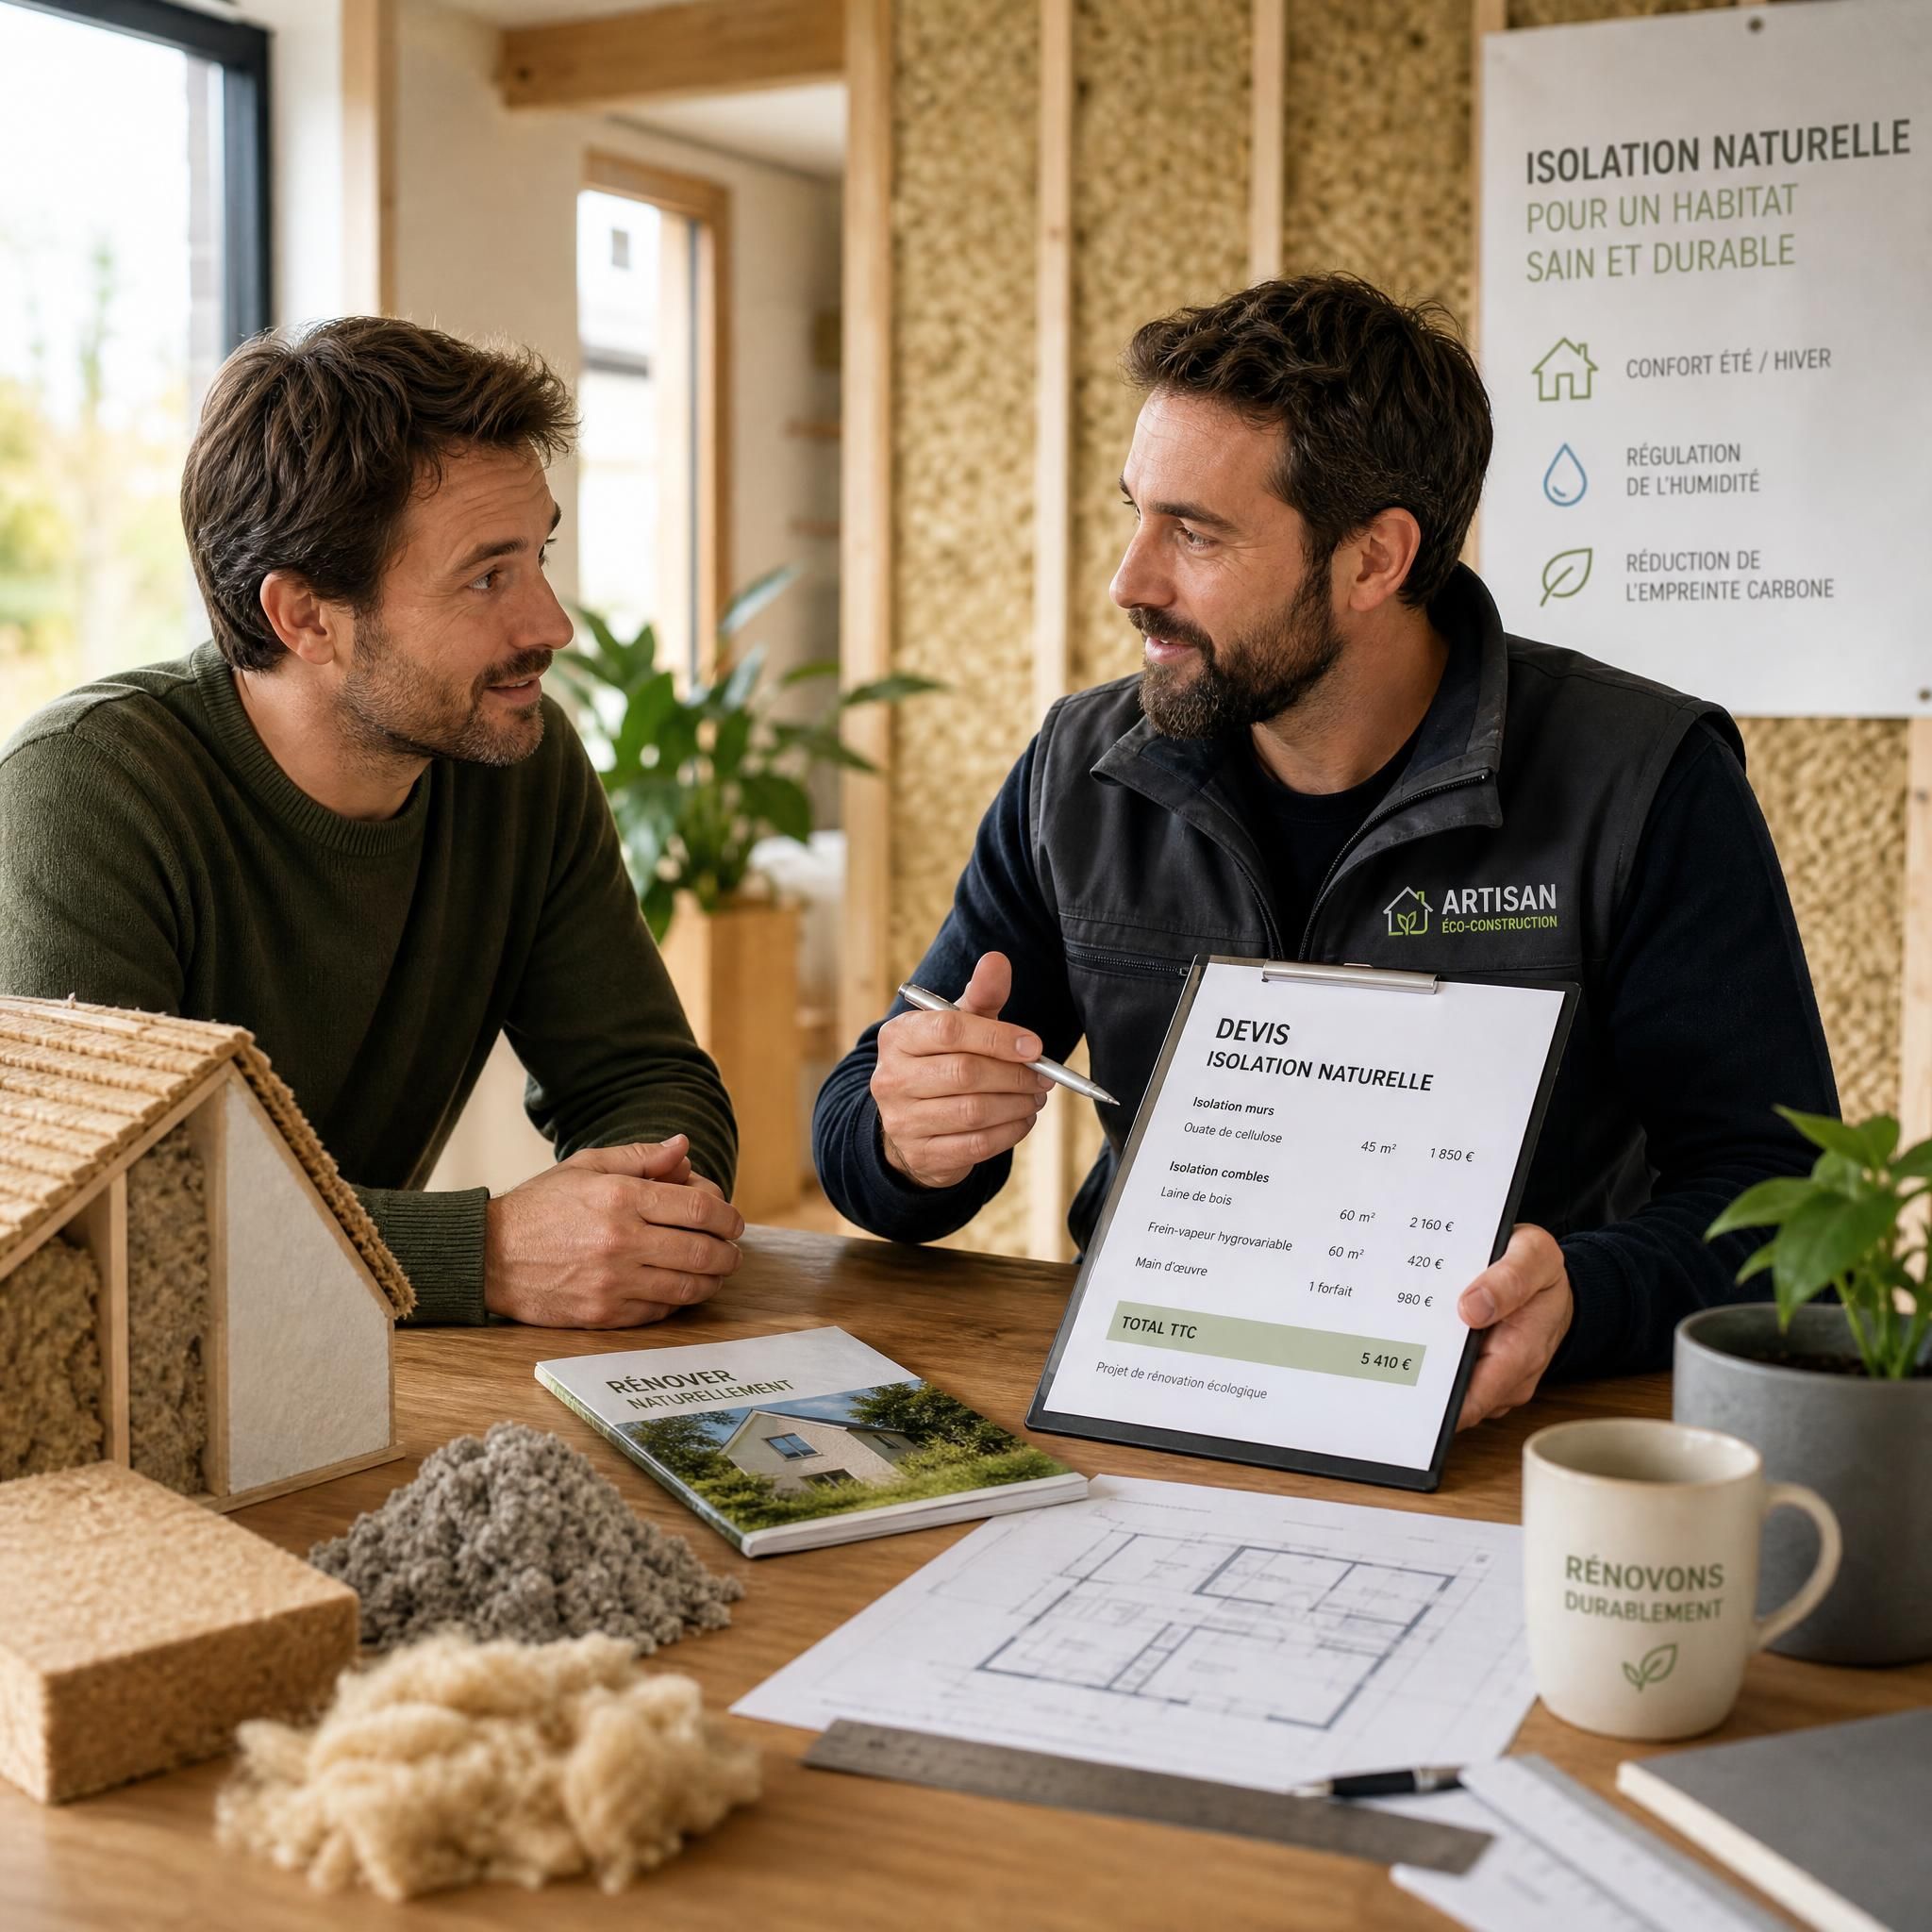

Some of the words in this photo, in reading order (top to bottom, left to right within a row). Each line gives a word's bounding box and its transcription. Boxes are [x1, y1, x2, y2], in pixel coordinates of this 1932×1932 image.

[1527, 138, 1699, 184] ISOLATION
[1714, 119, 1910, 170] NATURELLE
[1527, 198, 1607, 234] POUR
[1620, 193, 1660, 227] UN
[1674, 183, 1798, 223] HABITAT
[1526, 247, 1594, 282] SAIN
[1607, 244, 1642, 277] ET
[1654, 233, 1795, 275] DURABLE
[1626, 355, 1713, 379] CONFORT
[1721, 348, 1752, 374] ÉTÉ
[1758, 350, 1768, 374] /
[1774, 348, 1831, 370] HIVER
[1627, 443, 1740, 466] RÉGULATION
[1627, 476, 1650, 496] DE
[1626, 549, 1730, 573] RÉDUCTION
[1737, 550, 1760, 570] DE
[1747, 578, 1834, 600] CARBONE
[1441, 884, 1556, 915] ARTISAN
[1442, 915, 1557, 933] ÉCO-CONSTRUCTION
[1215, 1018, 1291, 1045] DEVIS
[1207, 1051, 1313, 1077] ISOLATION
[1318, 1063, 1434, 1091] NATURELLE
[1193, 1096, 1242, 1112] Isolation
[1245, 1106, 1274, 1116] murs
[1184, 1122, 1216, 1135] Ouate
[1219, 1126, 1232, 1138] de
[1235, 1129, 1282, 1143] cellulose
[1361, 1141, 1376, 1152] 45
[1380, 1143, 1396, 1154] m²
[1431, 1148, 1436, 1158] 1
[1439, 1149, 1462, 1161] 850
[1465, 1151, 1474, 1162] €
[1170, 1161, 1218, 1176] Isolation
[1222, 1170, 1270, 1183] combles
[1160, 1186, 1190, 1200] Laine
[1192, 1191, 1207, 1202] de
[1208, 1192, 1232, 1206] bois
[1340, 1209, 1355, 1221] 60
[1358, 1212, 1375, 1223] m²
[1409, 1217, 1418, 1228] 2
[1422, 1219, 1441, 1230] 160
[1445, 1222, 1454, 1232] €
[1147, 1222, 1216, 1241] Frein-vapeur
[1218, 1231, 1292, 1251] hygrovariable
[1328, 1246, 1344, 1257] 60
[1347, 1249, 1364, 1259] m²
[1407, 1256, 1431, 1268] 420
[1435, 1258, 1443, 1270] €
[1135, 1257, 1161, 1271] Main
[1309, 1281, 1314, 1291] 1
[1318, 1282, 1353, 1297] forfait
[1397, 1292, 1421, 1305] 980
[1424, 1296, 1433, 1307] €
[1123, 1316, 1164, 1334] TOTAL
[1171, 1324, 1197, 1339] TTC
[1361, 1352, 1371, 1365] 5
[1374, 1355, 1398, 1369] 410
[1402, 1358, 1412, 1371] €
[606, 1370, 738, 1394] RÉNOVER
[1096, 1361, 1128, 1377] Projet
[1130, 1367, 1144, 1379] de
[1147, 1371, 1205, 1389] rénovation
[1207, 1380, 1267, 1400] écologique
[626, 1379, 794, 1409] NATURELLEMENT
[1564, 1554, 1725, 1592] RÉNOVONS
[1564, 1591, 1724, 1624] DURABLEMENT
